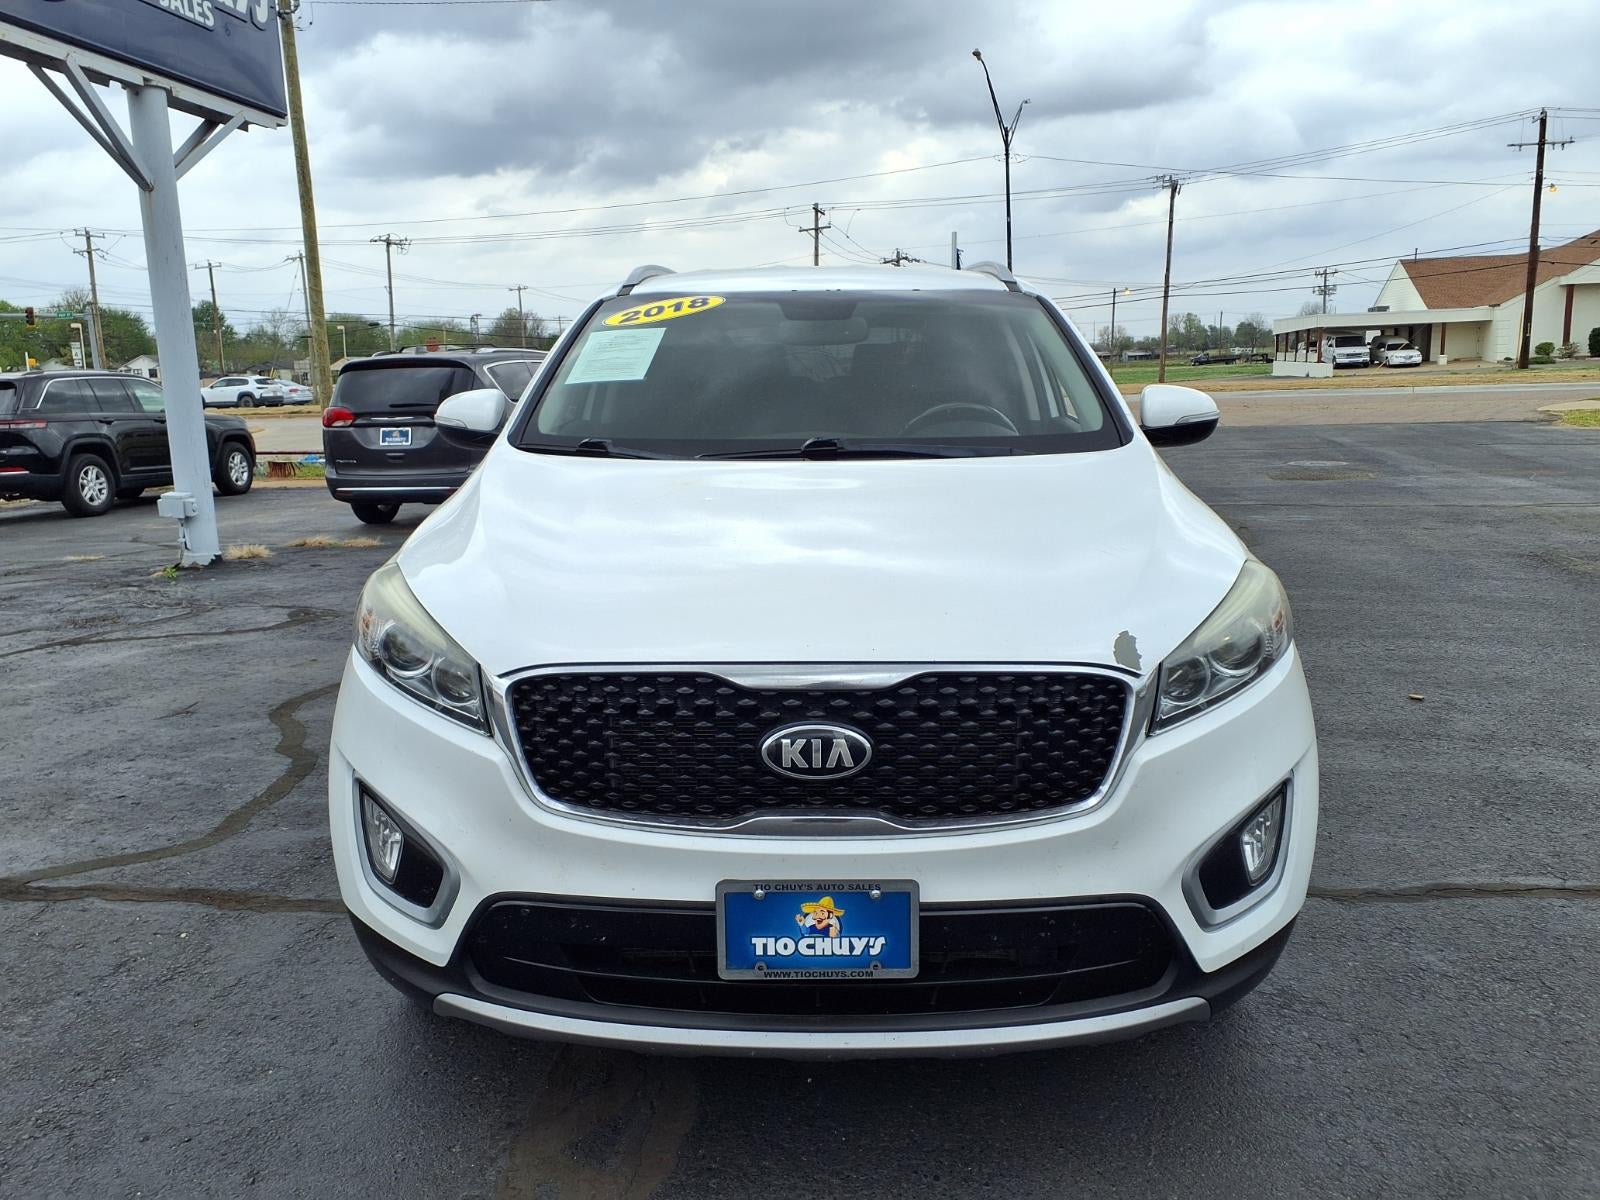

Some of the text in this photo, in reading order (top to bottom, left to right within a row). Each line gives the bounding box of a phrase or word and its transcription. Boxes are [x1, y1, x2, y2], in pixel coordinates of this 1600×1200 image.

[618, 297, 710, 324] 2018
[781, 738, 854, 768] KIA
[754, 883, 881, 892] TIO CHUY'S AUTO SALES
[764, 970, 874, 978] WWW.TIOCHUYS.COM
